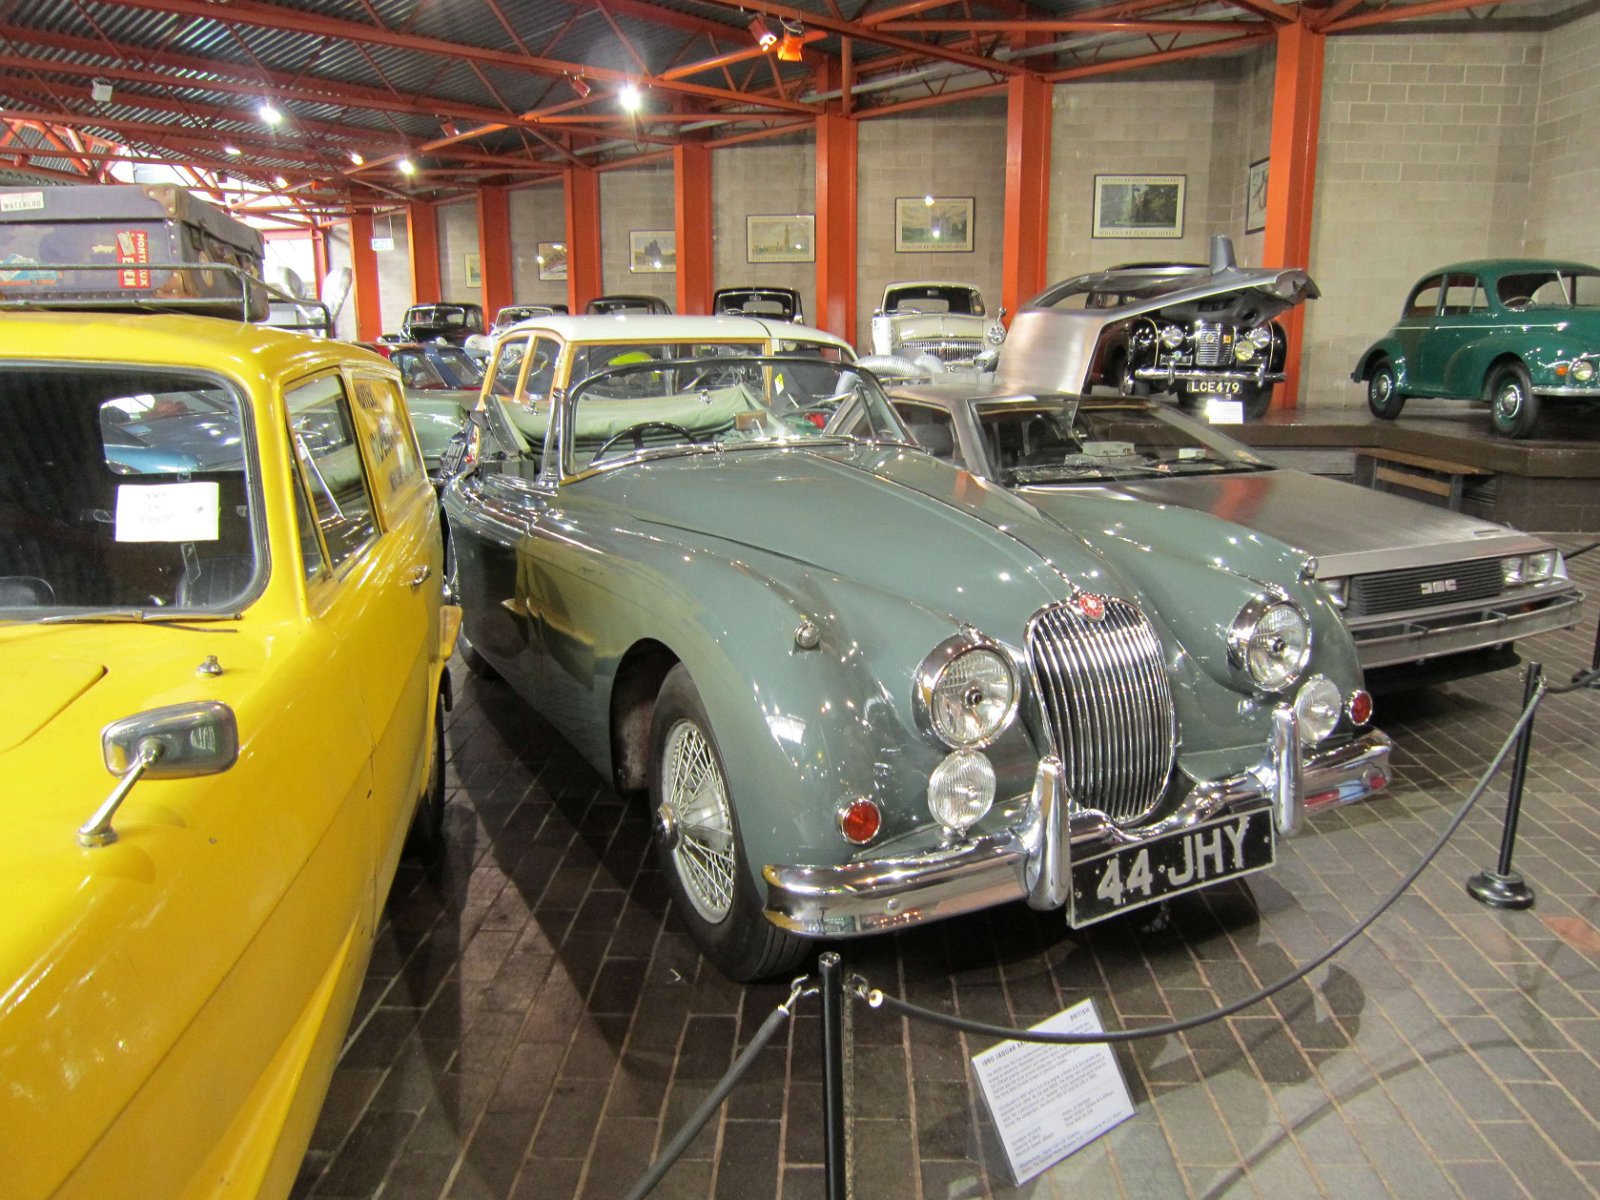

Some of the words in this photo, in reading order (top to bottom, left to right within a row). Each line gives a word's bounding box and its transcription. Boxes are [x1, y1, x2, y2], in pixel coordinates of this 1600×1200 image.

[122, 257, 136, 286] EEN
[137, 233, 148, 286] MONTUX
[1191, 381, 1240, 394] LCE479
[1420, 579, 1457, 595] DMC
[1097, 848, 1154, 906] 44
[1167, 815, 1250, 886] JHY
